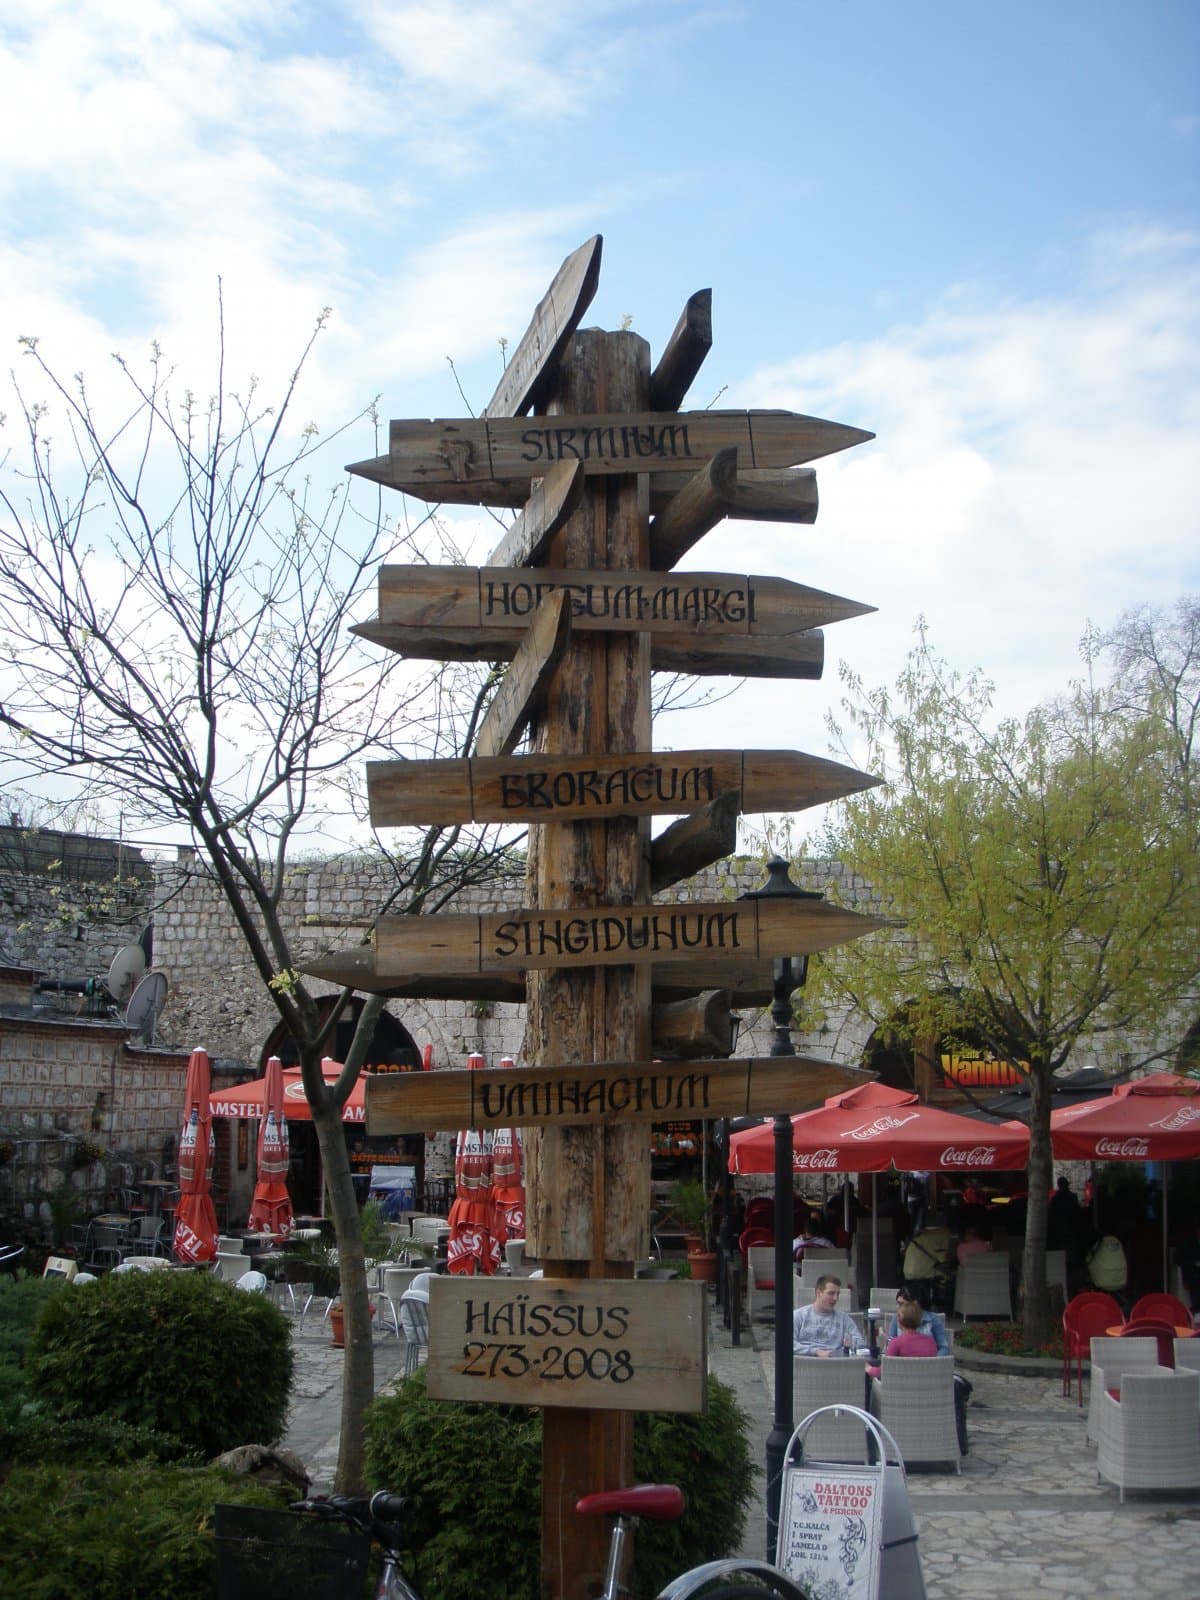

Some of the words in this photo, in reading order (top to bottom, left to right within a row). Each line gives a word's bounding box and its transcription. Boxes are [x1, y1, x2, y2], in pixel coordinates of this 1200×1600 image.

[520, 424, 692, 462] SIRMIUM
[498, 766, 714, 809] EBORACUM
[940, 1146, 996, 1166] Coca-Cola
[1095, 1136, 1151, 1157] Coca-Cola
[792, 1149, 840, 1169] oca-Cola
[464, 1294, 630, 1340] HAÏSSUS
[815, 1482, 873, 1497] DALTONS
[817, 1494, 868, 1508] TATTOO
[830, 1507, 864, 1517] PIERCING
